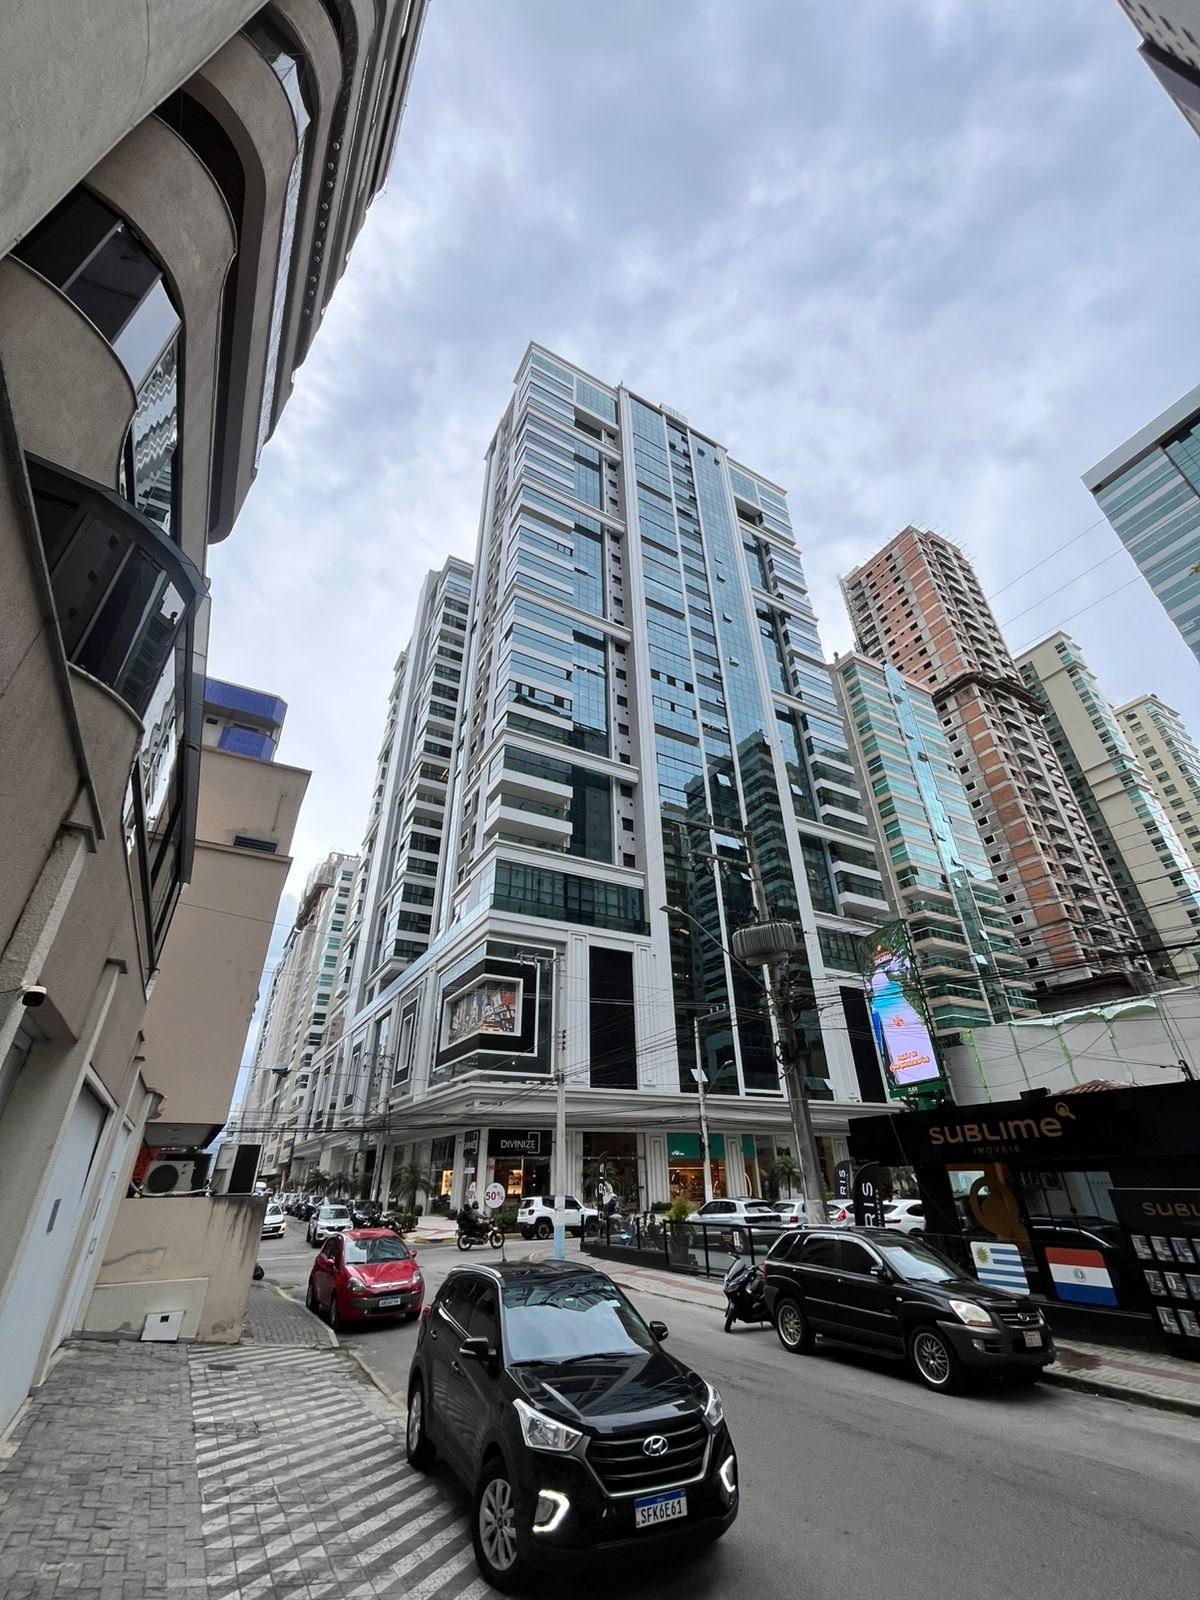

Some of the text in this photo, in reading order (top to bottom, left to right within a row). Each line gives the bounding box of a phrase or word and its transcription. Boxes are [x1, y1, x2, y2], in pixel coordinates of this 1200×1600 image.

[500, 1139, 536, 1149] DIVINIZE
[485, 1191, 504, 1201] 50%
[640, 1499, 682, 1524] SFK6E61
